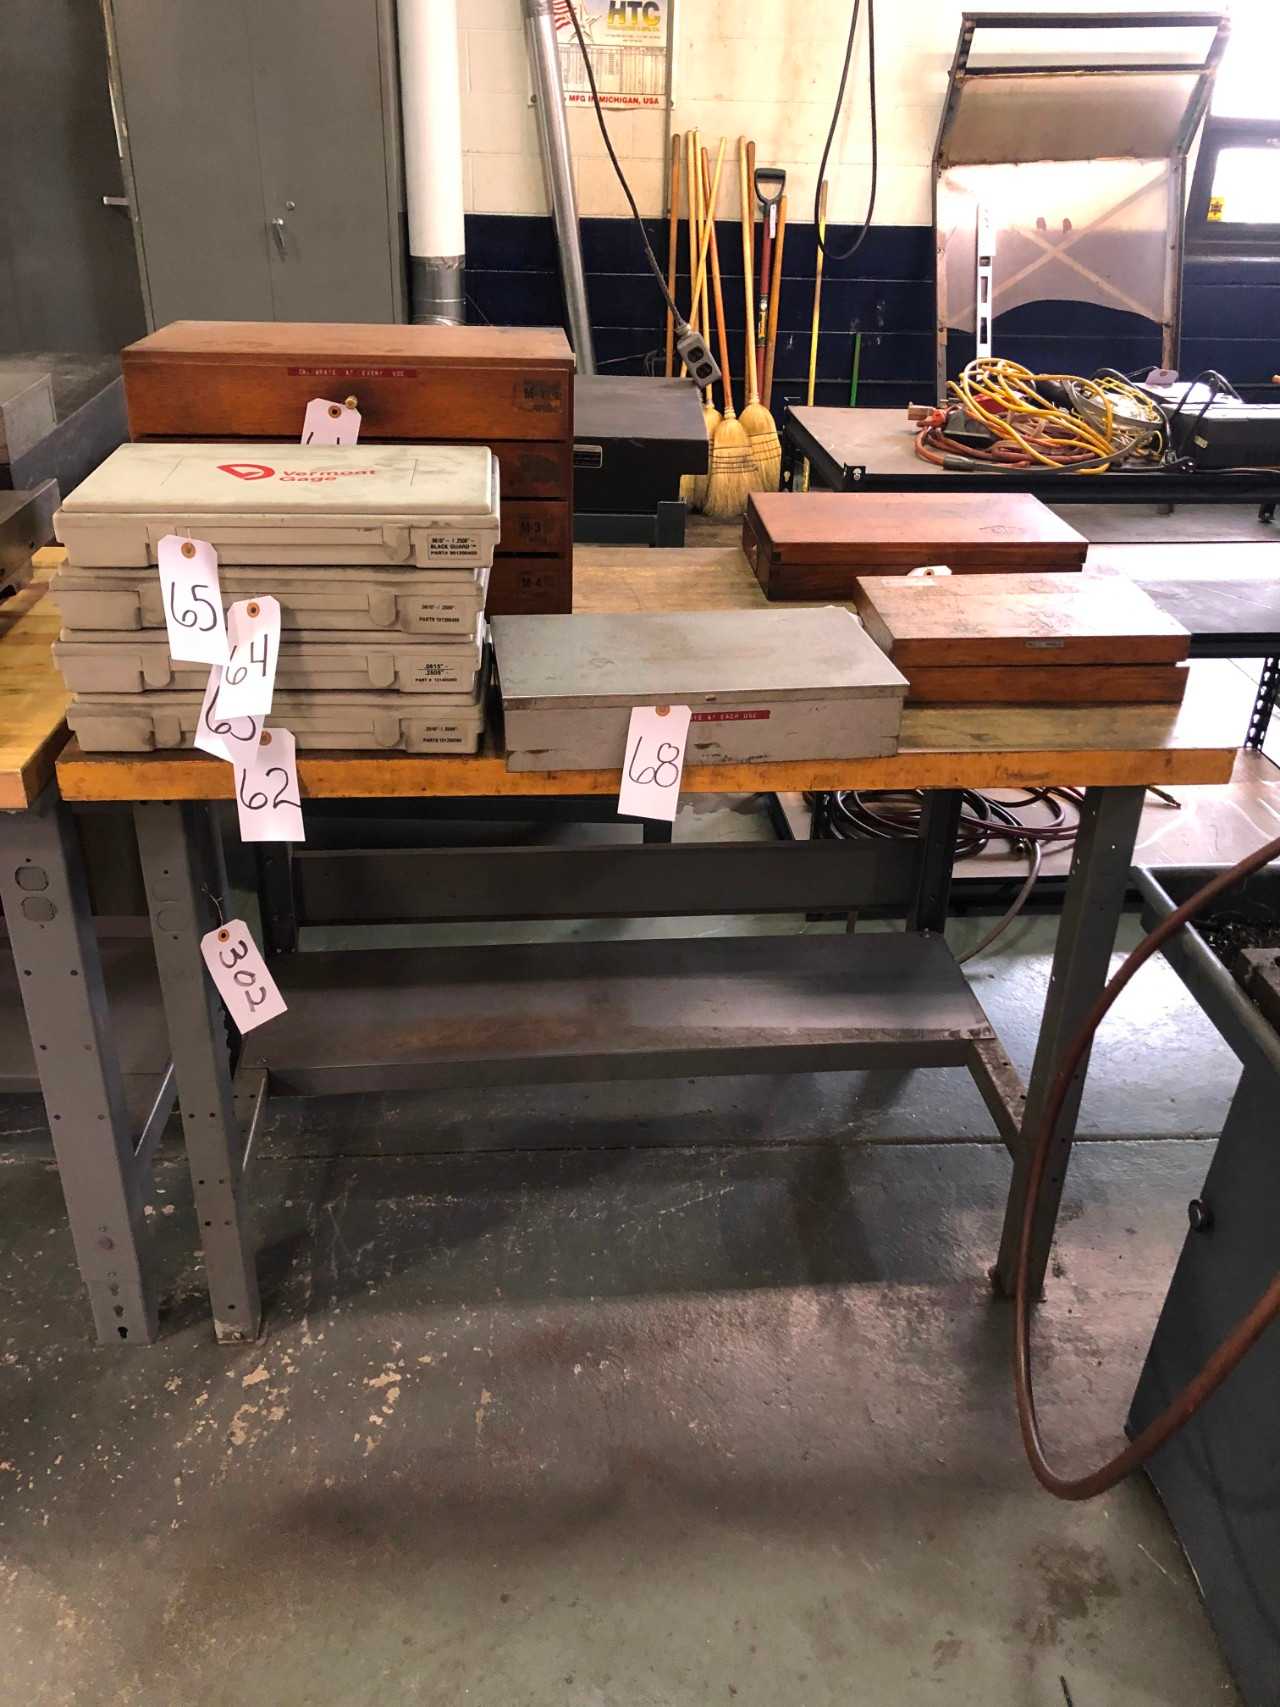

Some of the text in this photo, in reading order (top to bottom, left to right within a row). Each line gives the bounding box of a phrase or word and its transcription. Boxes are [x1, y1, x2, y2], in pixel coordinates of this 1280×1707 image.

[608, 0, 661, 26] HTC
[599, 95, 641, 105] MICHIGAN,
[643, 97, 660, 105] USA
[283, 469, 377, 477] Vermont
[170, 581, 217, 632] 65
[226, 633, 269, 686] 64
[628, 736, 680, 788] 68
[240, 767, 302, 810] 62
[219, 940, 267, 1013] 302
